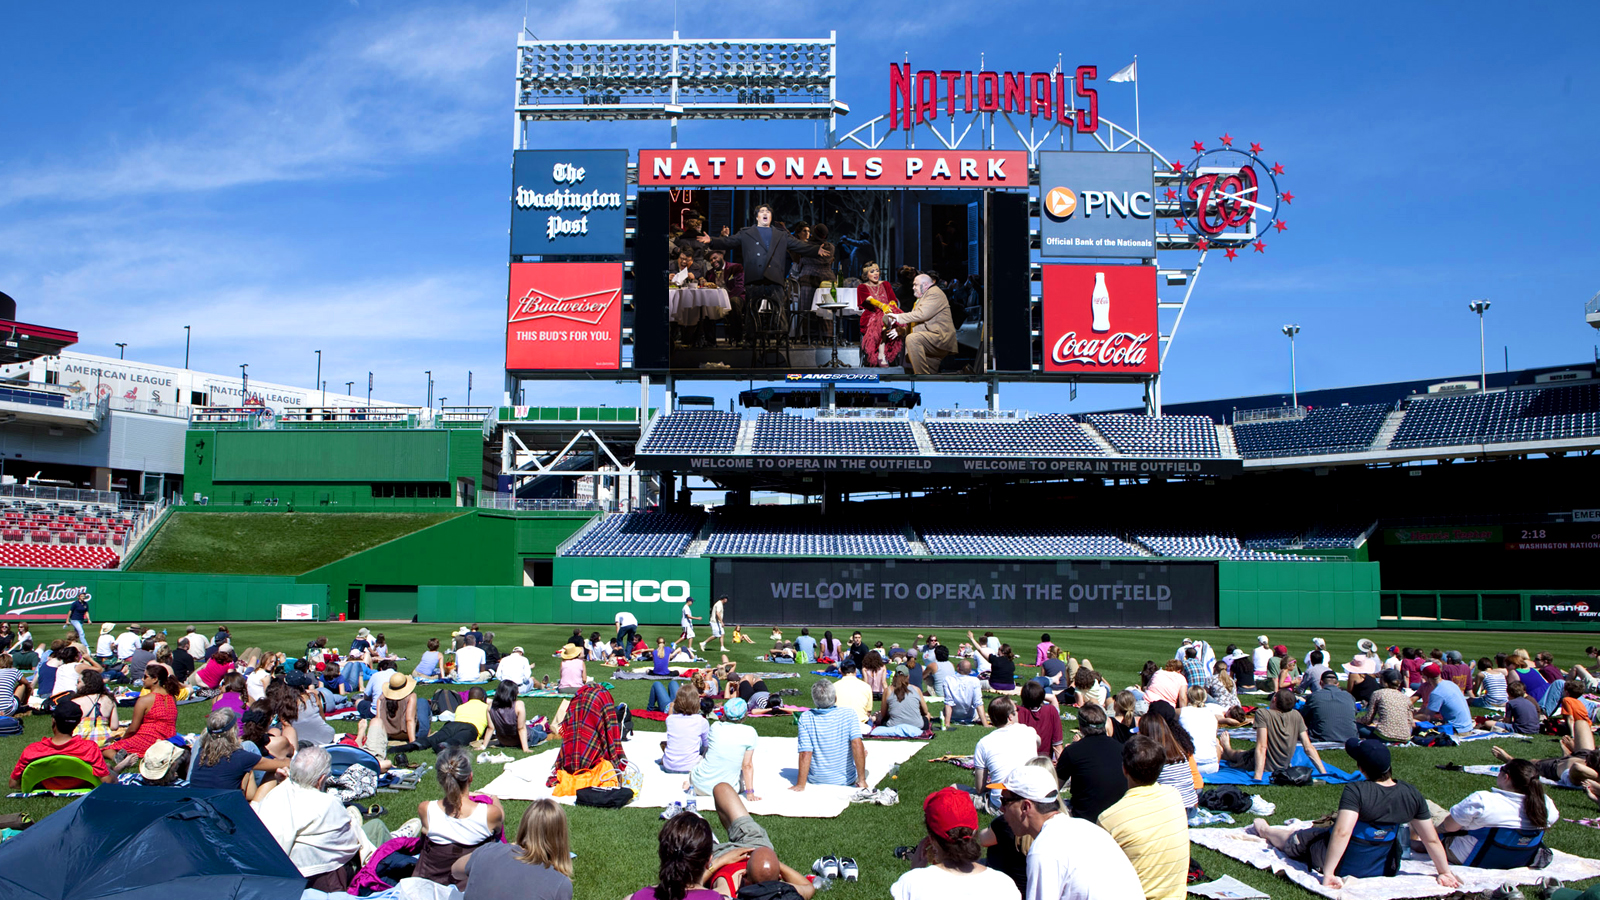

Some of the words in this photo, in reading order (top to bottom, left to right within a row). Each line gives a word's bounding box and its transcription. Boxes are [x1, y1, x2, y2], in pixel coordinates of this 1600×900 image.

[890, 62, 1098, 134] NATIONALS
[553, 162, 586, 185] The
[653, 156, 884, 179] NATIONALS
[905, 157, 1007, 180] PARK
[516, 185, 622, 213] Washington
[1080, 190, 1152, 218] PNC
[546, 215, 589, 240] Post
[1046, 237, 1073, 246] Official
[1075, 238, 1094, 246] Bank
[1095, 238, 1103, 247] of
[1103, 238, 1116, 247] the
[1116, 239, 1153, 247] Nationals
[519, 296, 608, 314] Budweiser
[516, 331, 538, 341] THIS
[539, 331, 568, 341] BUD'S
[569, 331, 588, 341] FOR
[590, 331, 612, 341] YOU.
[1052, 331, 1154, 364] Coca-Cola
[64, 364, 127, 381] AMERICAN
[130, 374, 172, 387] LEAGUE
[266, 393, 301, 406] LEAGUE
[690, 458, 753, 468] WELCOME
[757, 458, 774, 468] TO
[777, 458, 820, 469] OPERA
[823, 459, 837, 469] IN
[840, 459, 866, 469] THE
[869, 459, 932, 469] OUTFIELD
[963, 460, 1026, 470] WELCOME
[1029, 461, 1047, 470] TO
[1050, 461, 1092, 471] OPERA
[1095, 461, 1108, 471] IN
[1112, 462, 1137, 471] THE
[1140, 462, 1201, 472] OUTFIELD
[1521, 529, 1546, 539] 2:18
[1518, 542, 1568, 550] WASHINGTON
[570, 579, 691, 603] GEICO
[770, 582, 875, 599] WELCOME
[881, 583, 910, 599] TO
[915, 583, 986, 600] OPERA
[991, 584, 1016, 600] IN
[1022, 584, 1063, 600] THE
[1069, 584, 1172, 602] OUTFIELD
